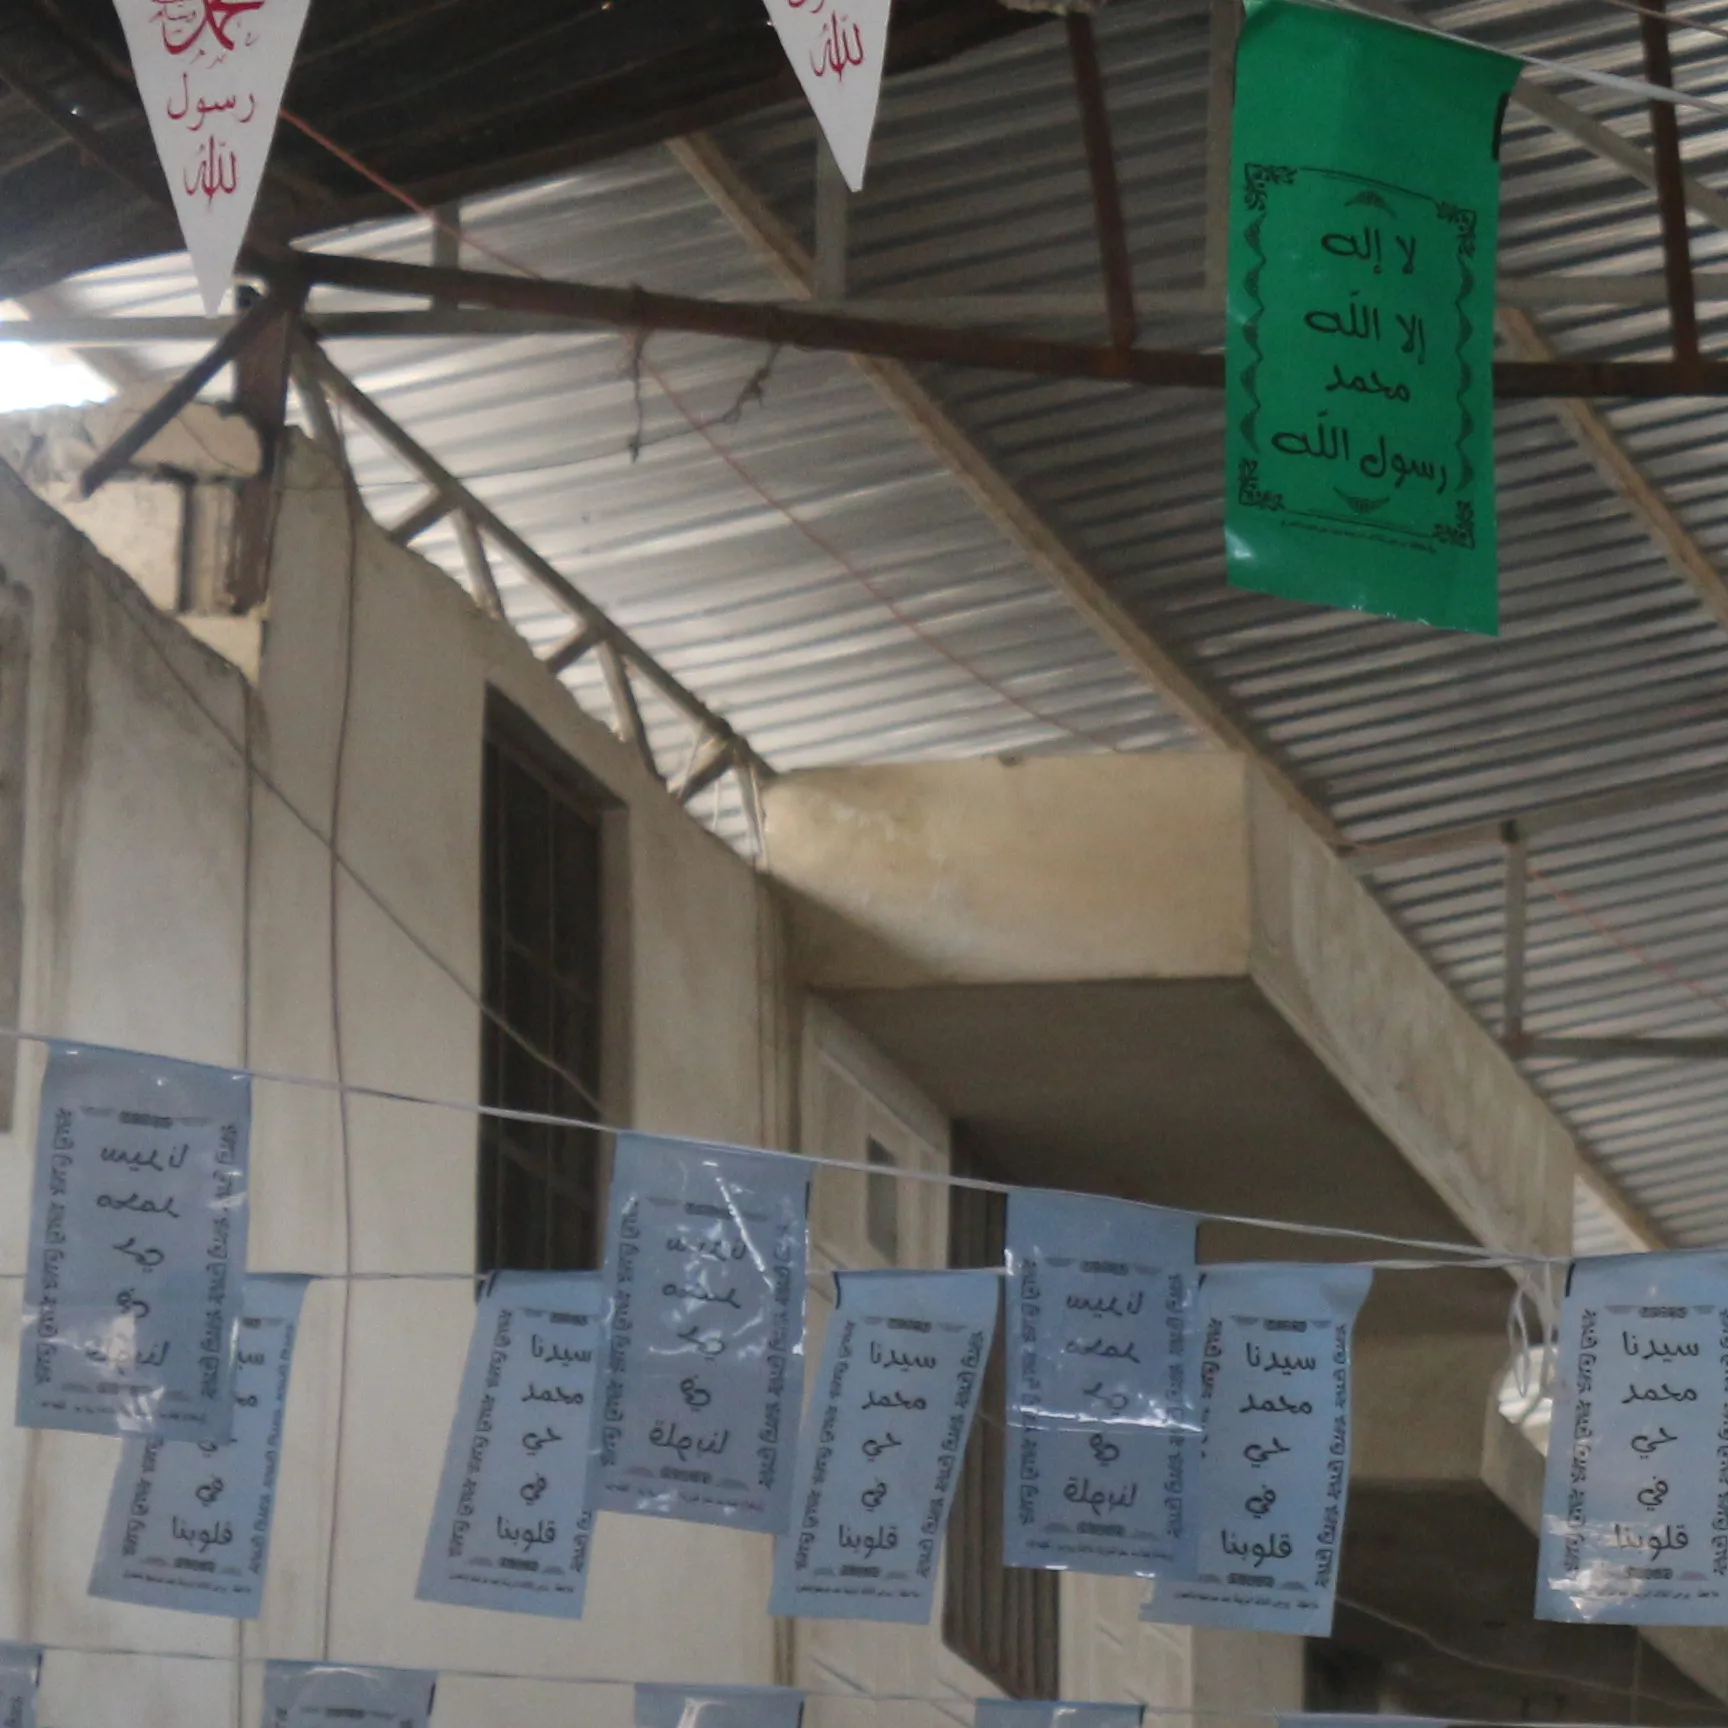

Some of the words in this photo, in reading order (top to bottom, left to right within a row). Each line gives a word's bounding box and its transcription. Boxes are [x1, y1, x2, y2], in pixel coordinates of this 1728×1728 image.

[808, 10, 864, 83] الله
[167, 73, 256, 131] رسول
[183, 134, 238, 213] الله
[1395, 229, 1416, 275] لا
[1303, 291, 1381, 340] الله
[1325, 365, 1410, 403] محمد
[1271, 410, 1350, 461] الله
[1360, 435, 1447, 495] رسول
[531, 1334, 592, 1367] سيدنا
[870, 1341, 937, 1372] سيدنا
[1246, 1342, 1317, 1376] سيدنا
[1622, 1331, 1700, 1362] سيدنا
[521, 1383, 585, 1405] محمد
[861, 1391, 927, 1410] محمد
[1239, 1394, 1313, 1415] محمد
[1621, 1383, 1698, 1404] محمد
[522, 1427, 562, 1456] حي
[862, 1432, 902, 1462] حي
[1243, 1437, 1291, 1468] حي
[1630, 1427, 1678, 1459] حي
[520, 1473, 548, 1506] في
[861, 1480, 887, 1512] في
[1244, 1485, 1277, 1519] في
[1636, 1475, 1669, 1512] في
[497, 1515, 556, 1552] قلوبنا
[838, 1524, 898, 1559] قلوبنا
[1220, 1529, 1293, 1568] قلوبنا
[1611, 1523, 1689, 1564] قلوبنا
